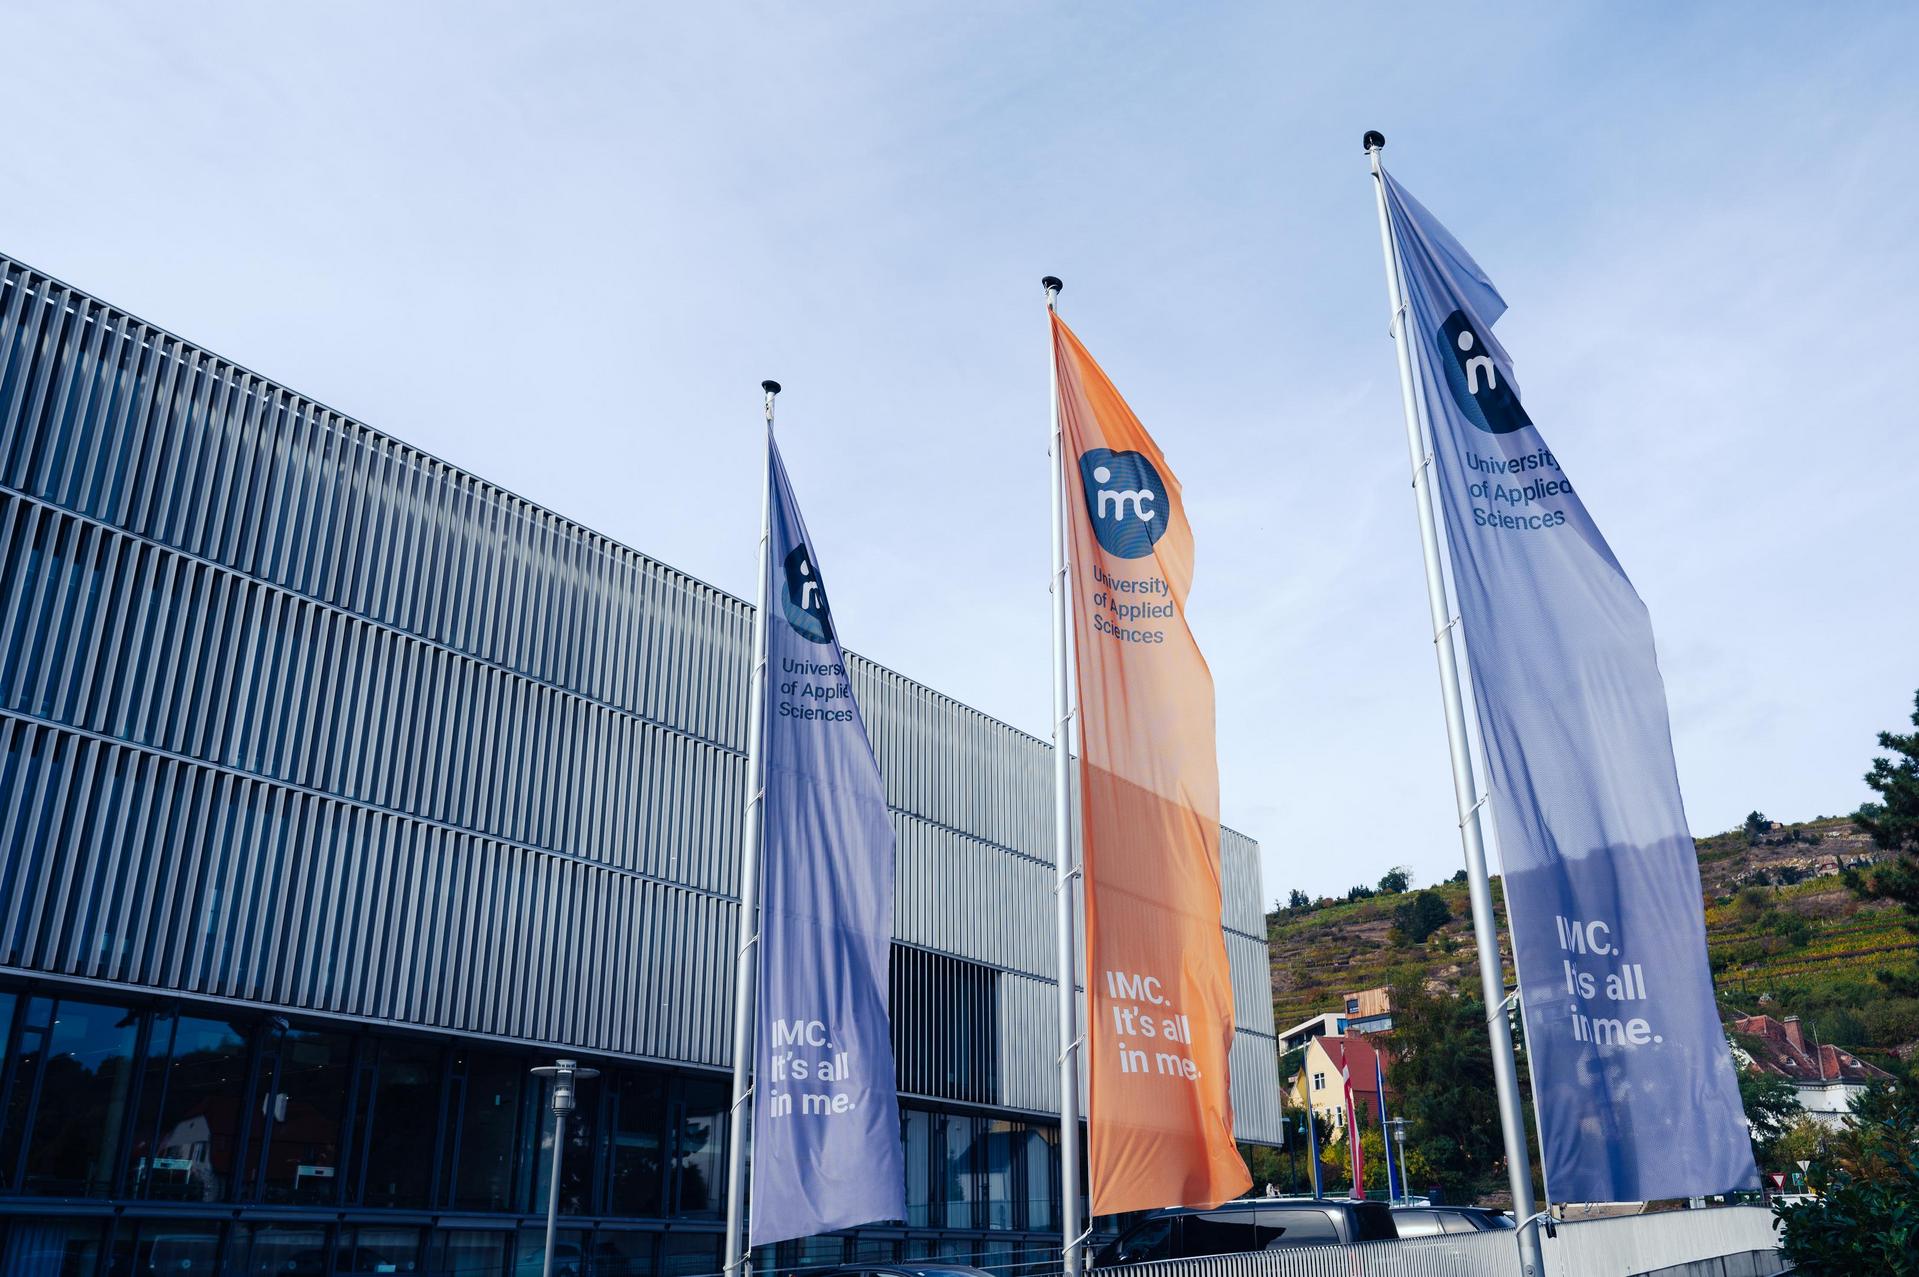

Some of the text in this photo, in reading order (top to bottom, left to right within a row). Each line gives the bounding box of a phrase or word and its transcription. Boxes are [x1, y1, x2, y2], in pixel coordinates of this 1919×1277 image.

[1470, 478, 1573, 507] of Applied
[1473, 507, 1566, 530] Sciences
[1093, 565, 1169, 596] University
[1093, 592, 1174, 622] of Applied
[1093, 614, 1164, 644] Sciences
[782, 657, 845, 677] Univers
[780, 681, 850, 702] of Applie
[779, 701, 853, 722] Sciences
[1106, 970, 1171, 1007] IMC.
[1606, 963, 1647, 1001] all
[771, 1018, 833, 1049] IMC.
[1112, 1006, 1192, 1045] It's all
[1593, 1017, 1664, 1046] me.
[771, 1051, 849, 1083] It's all
[1118, 1042, 1202, 1081] in me.
[770, 1089, 856, 1118] in me.
